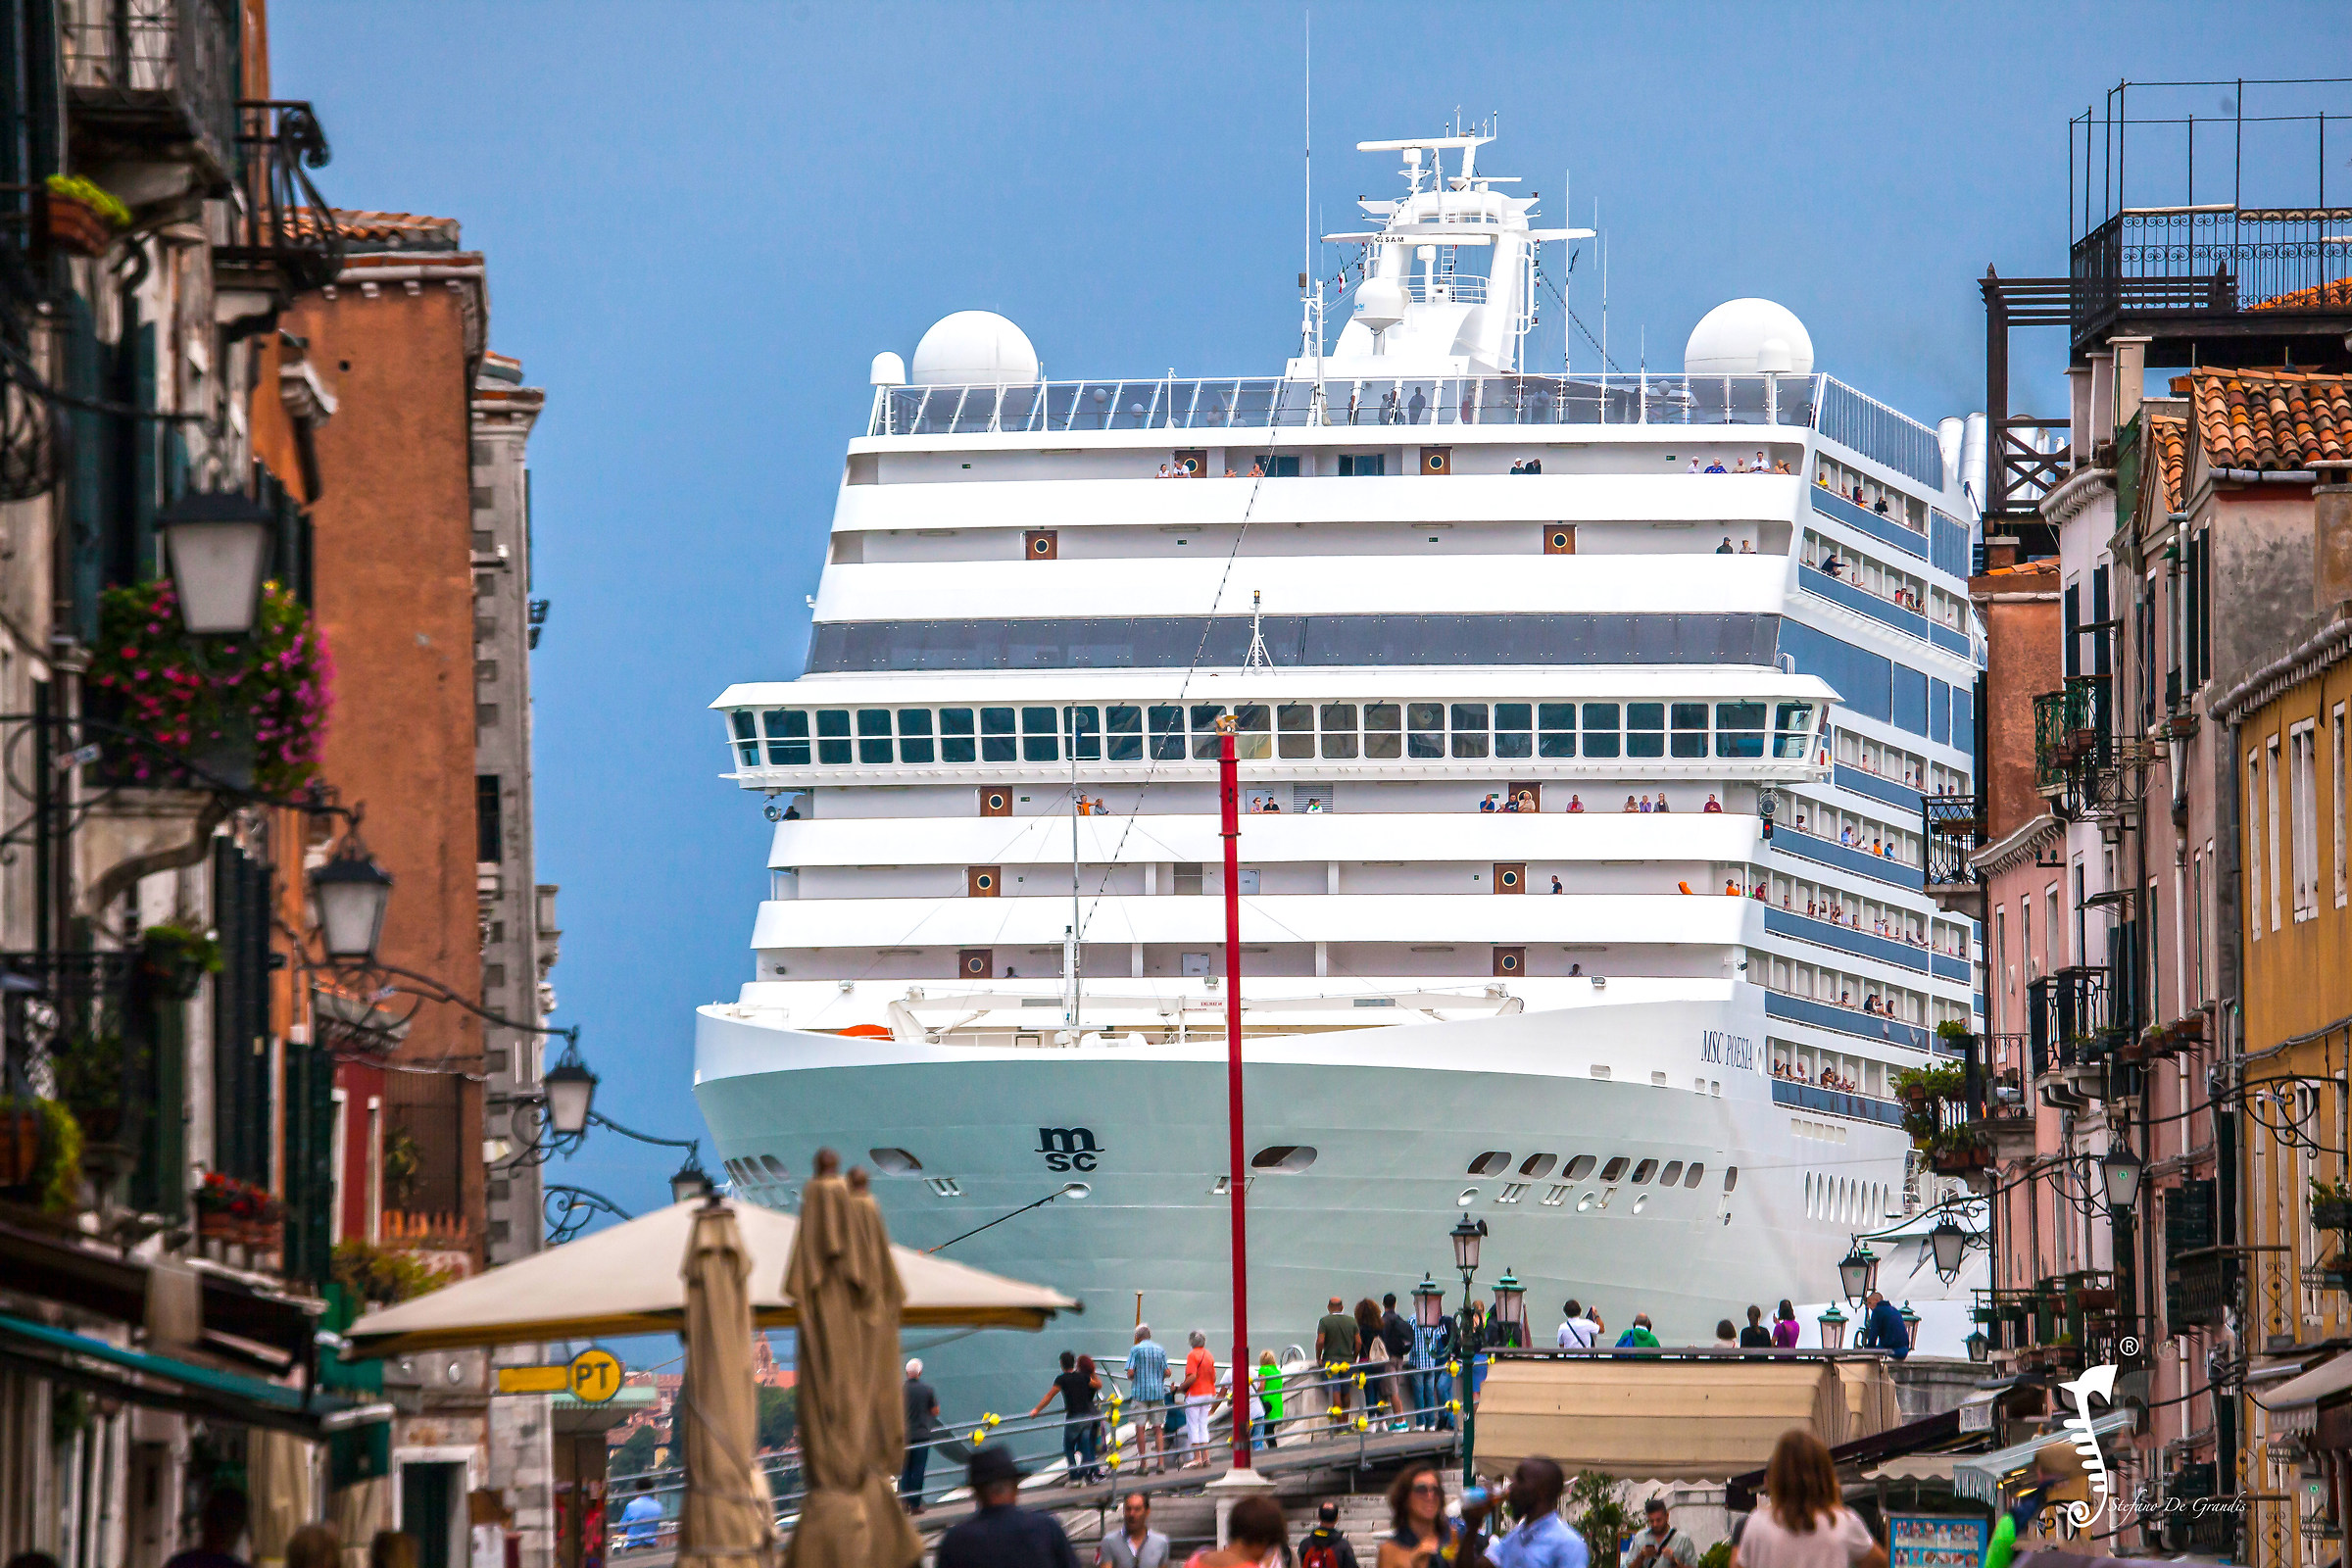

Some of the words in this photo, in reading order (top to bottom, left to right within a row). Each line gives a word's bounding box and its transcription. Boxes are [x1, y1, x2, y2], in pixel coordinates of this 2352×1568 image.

[1700, 1030, 1724, 1064] MSC
[1726, 1034, 1753, 1070] POESIA
[576, 1362, 611, 1390] PT
